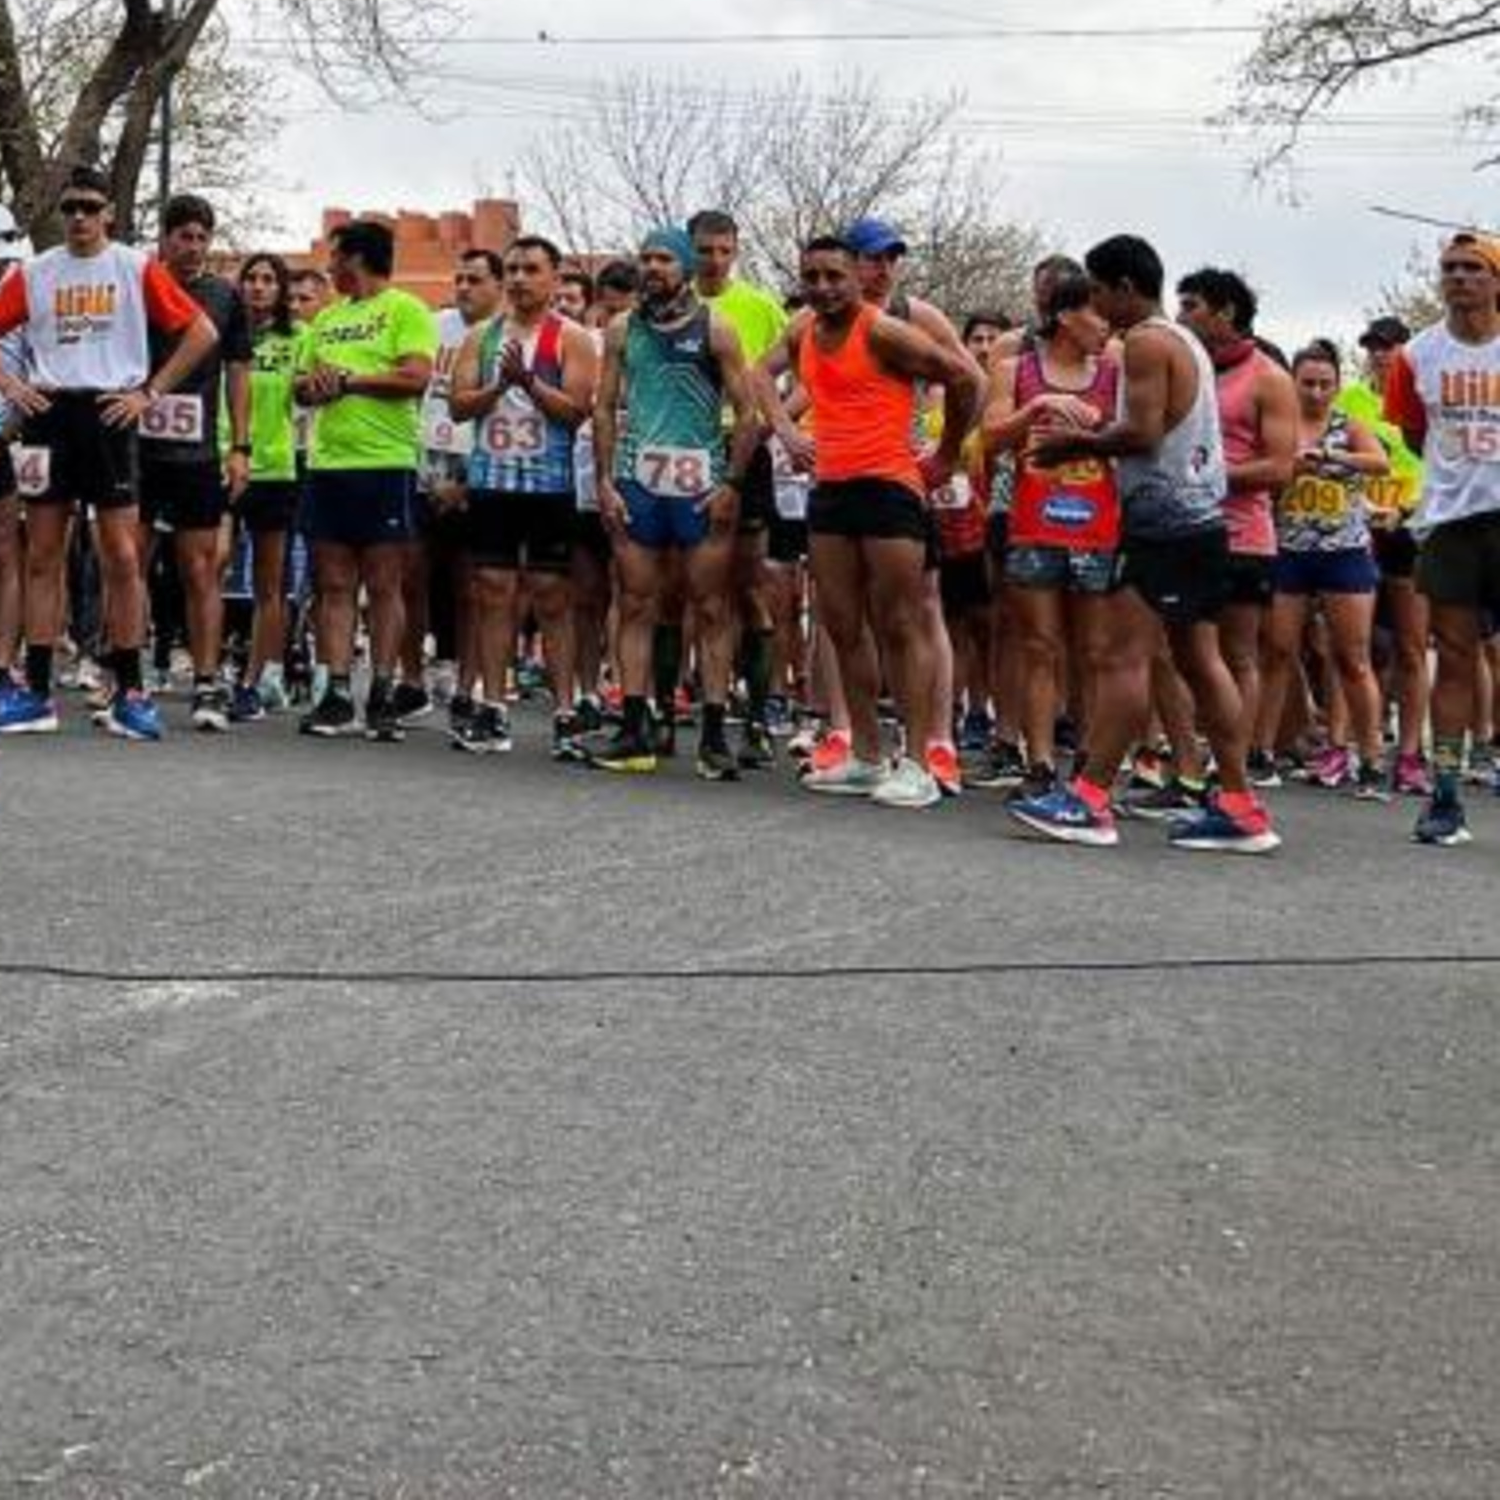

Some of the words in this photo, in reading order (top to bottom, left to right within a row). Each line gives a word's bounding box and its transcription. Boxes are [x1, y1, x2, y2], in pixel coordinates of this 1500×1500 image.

[142, 401, 197, 434] 65
[487, 416, 542, 450] 63
[643, 452, 703, 492] 78
